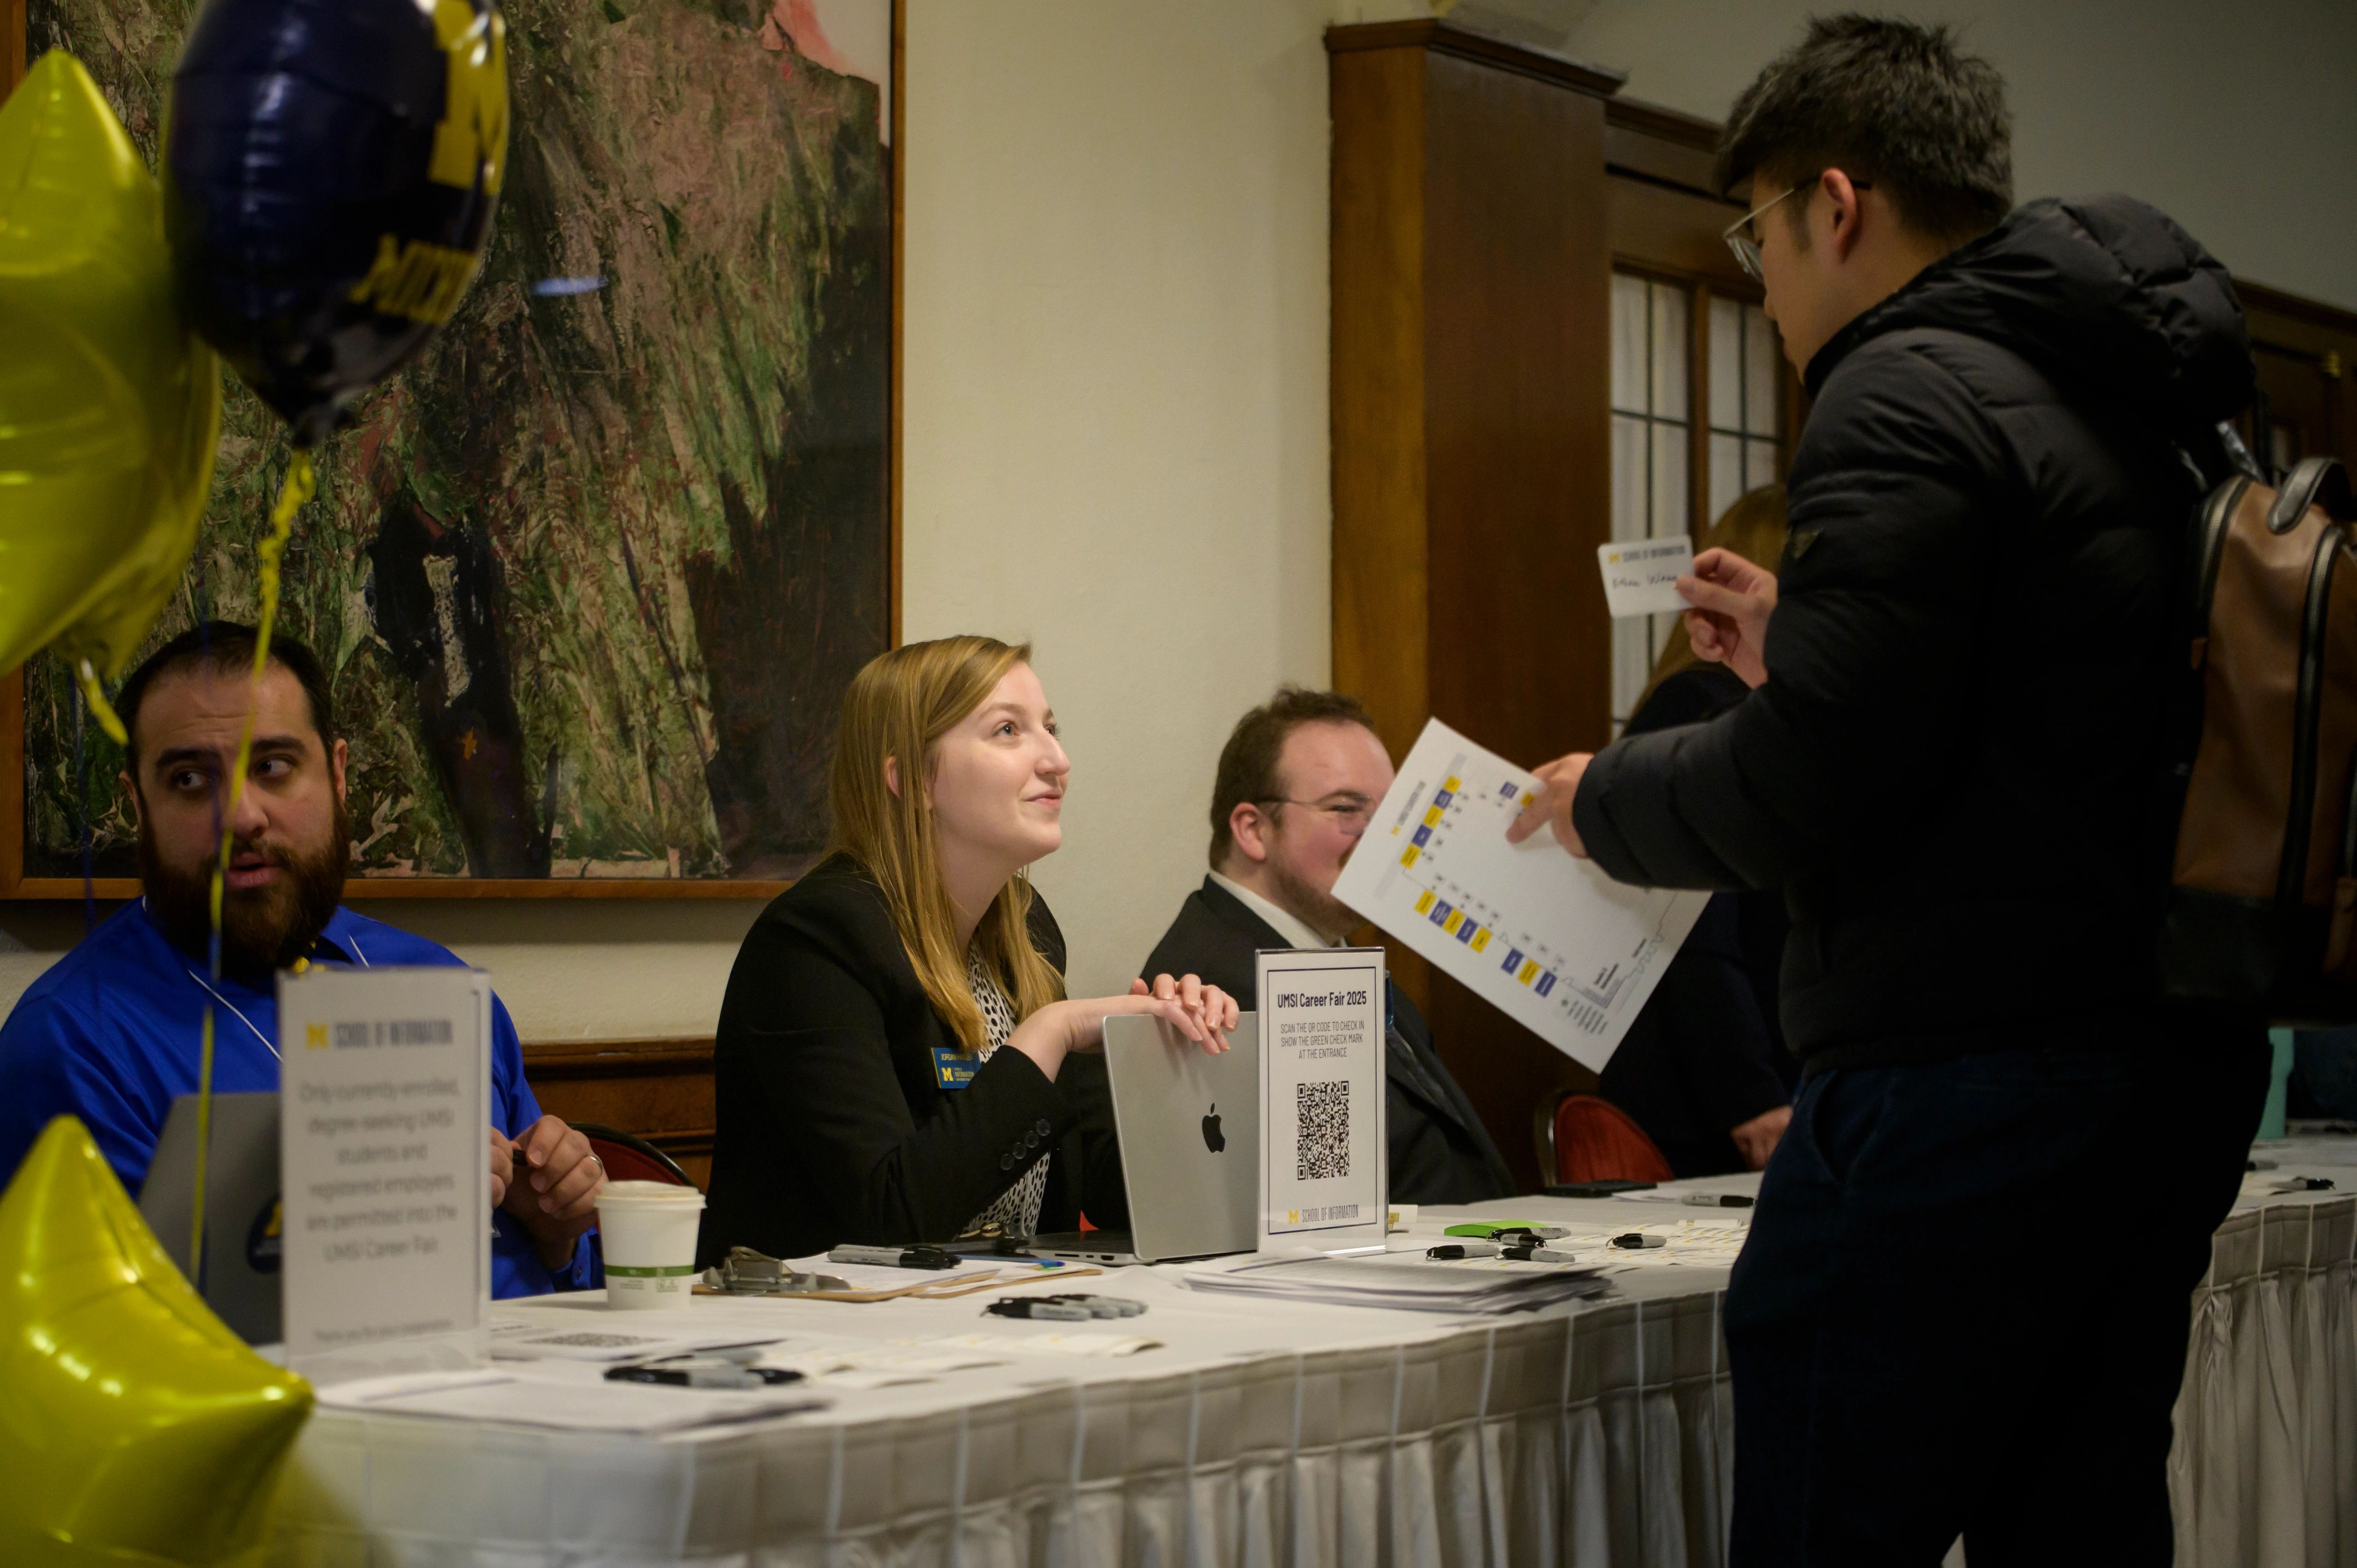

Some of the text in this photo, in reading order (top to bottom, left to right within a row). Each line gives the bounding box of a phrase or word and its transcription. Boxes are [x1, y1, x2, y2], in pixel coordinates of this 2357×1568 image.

[1277, 991, 1367, 1008] UMSI Career Fair 2025
[1281, 1020, 1364, 1034] SCAN THE QR CODE TO CHECK IN
[1281, 1034, 1363, 1047] SHOW THE GREEN CHECK MARK
[1299, 1047, 1347, 1059] AT THE ENTRANCE
[941, 1068, 953, 1081] M
[1289, 1204, 1358, 1224] M SCHOOL OF INFORMATION
